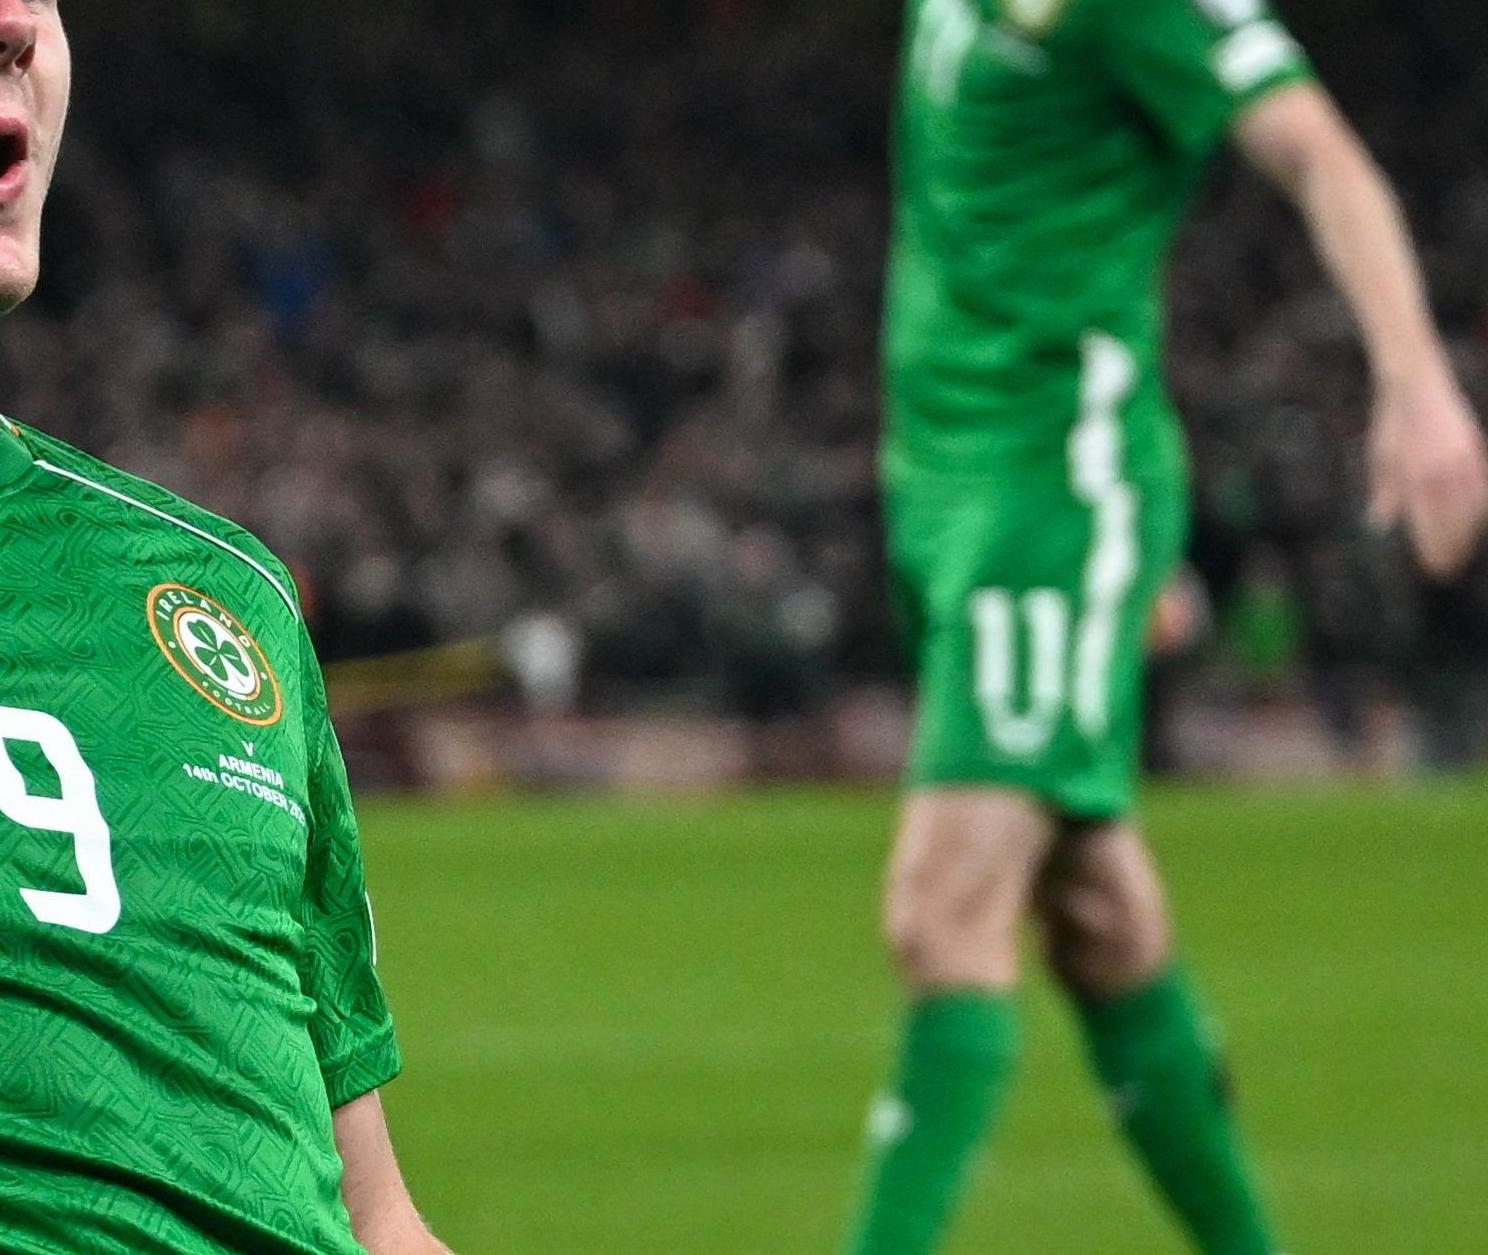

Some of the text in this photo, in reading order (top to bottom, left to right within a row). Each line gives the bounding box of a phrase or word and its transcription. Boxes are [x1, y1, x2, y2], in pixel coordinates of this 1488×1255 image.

[155, 590, 251, 649] IRELAND
[182, 762, 219, 784] 14th
[219, 771, 289, 812] OCTOBER
[218, 753, 285, 790] ARMENIA
